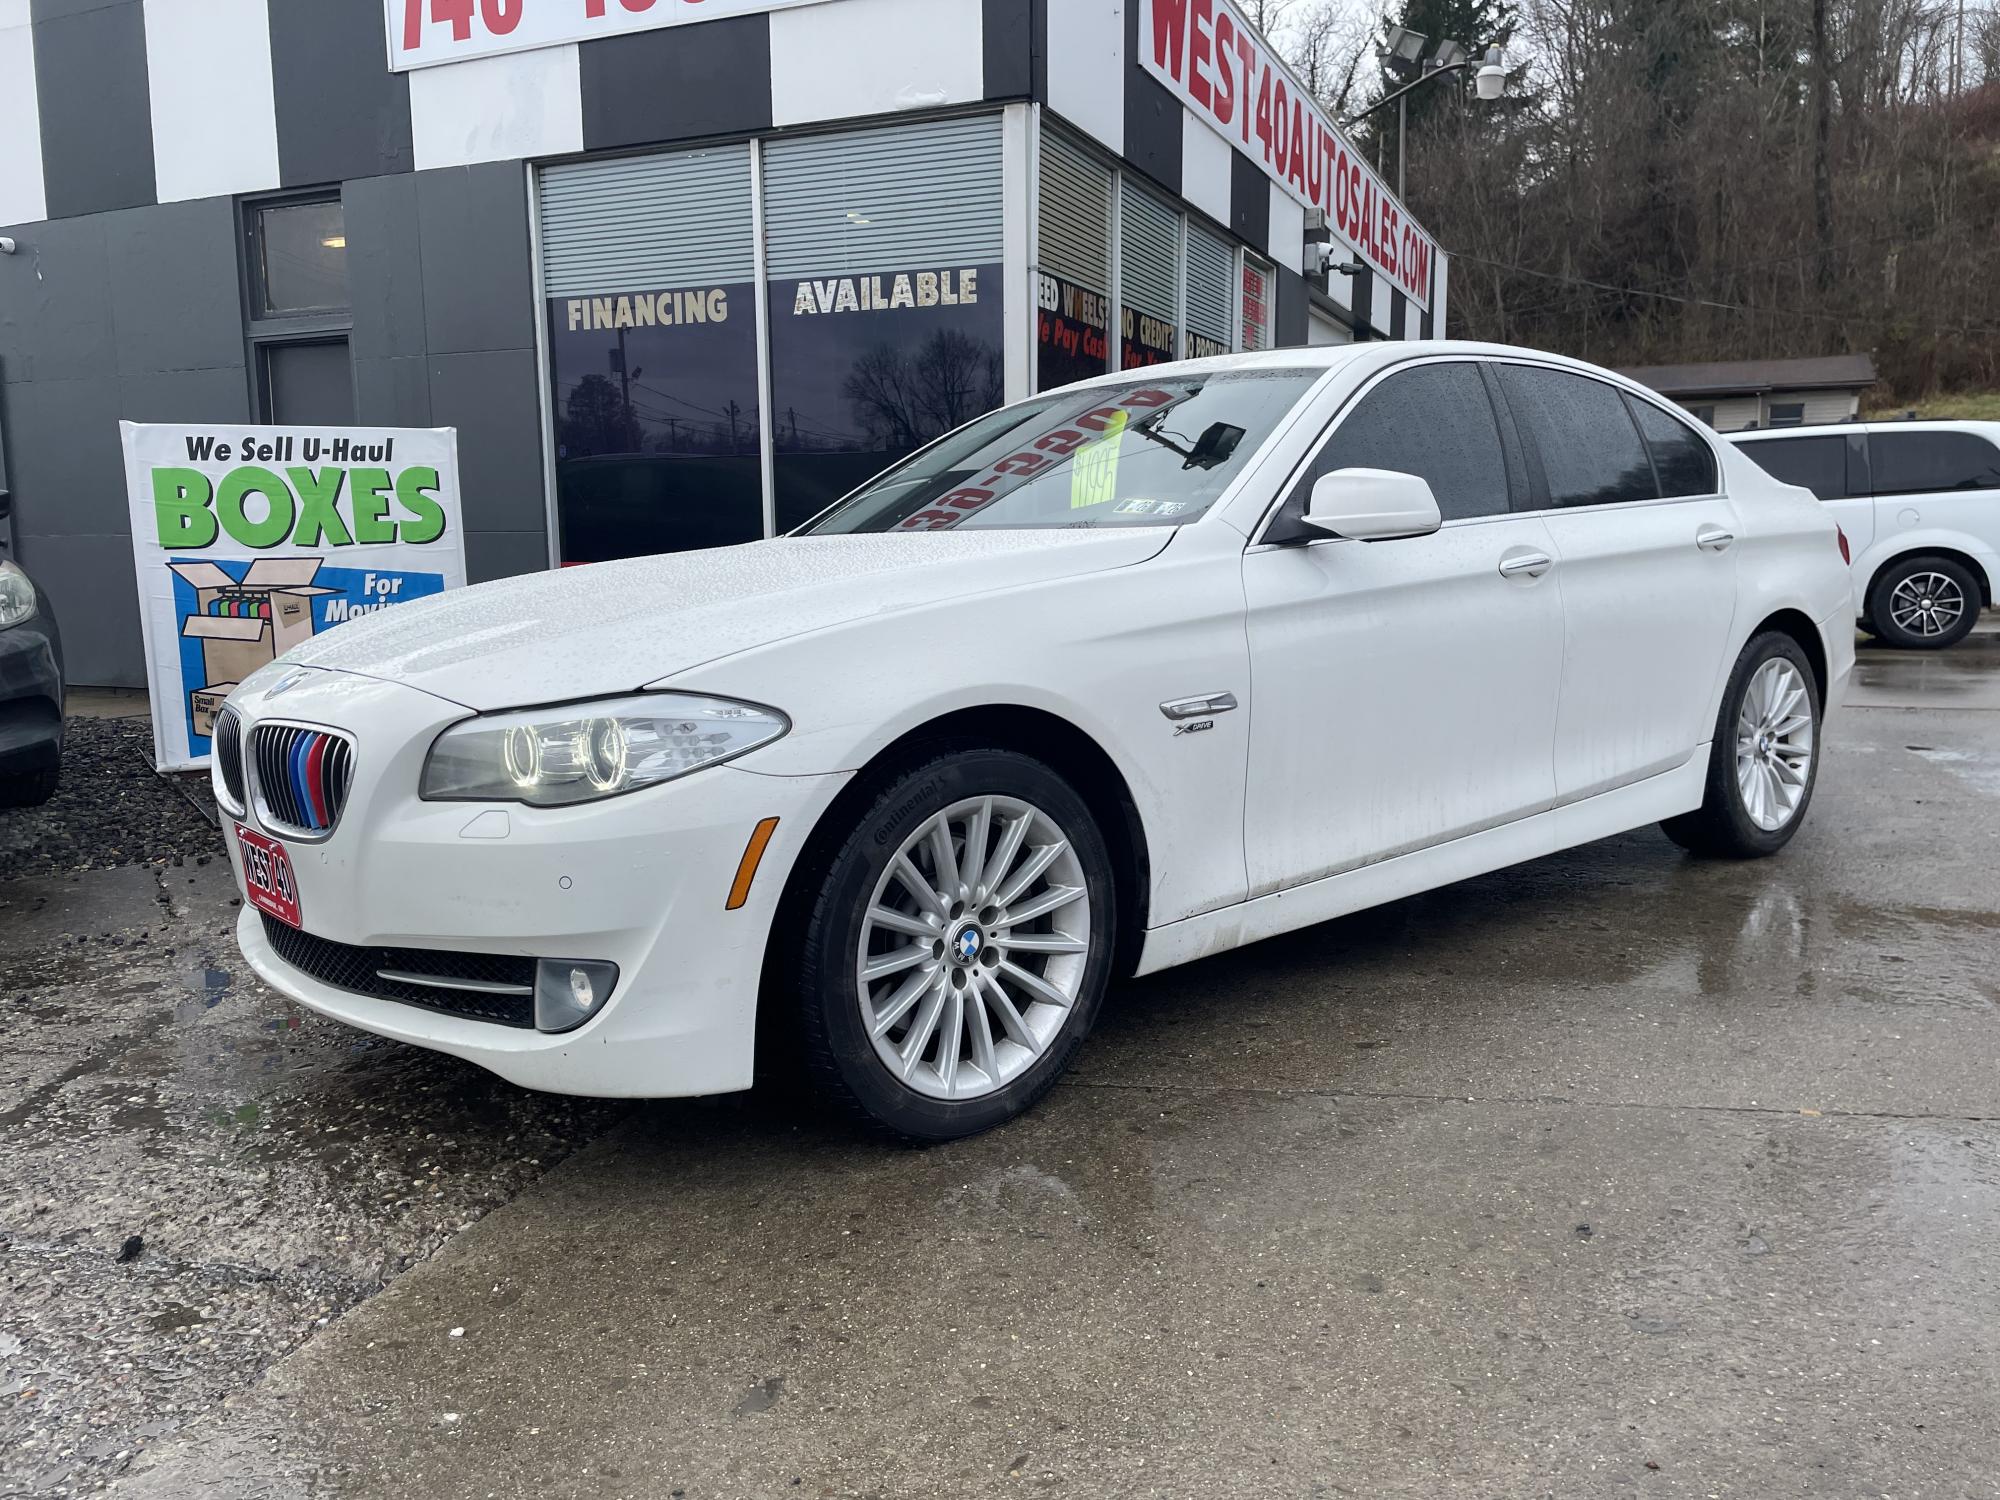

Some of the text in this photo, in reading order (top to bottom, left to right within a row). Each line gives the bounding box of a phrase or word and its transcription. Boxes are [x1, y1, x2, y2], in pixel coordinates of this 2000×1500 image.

[567, 269, 977, 331] FINANCING AVAILABLE
[1054, 318, 1079, 357] Pay
[1140, 314, 1174, 354] CREDIT?
[186, 436, 395, 462] We Sell U-Haul
[151, 465, 447, 550] BOXES
[364, 573, 403, 596] For
[194, 695, 215, 707] Small
[195, 705, 209, 714] Box
[238, 836, 277, 896] WEST
[272, 852, 295, 905] 40
